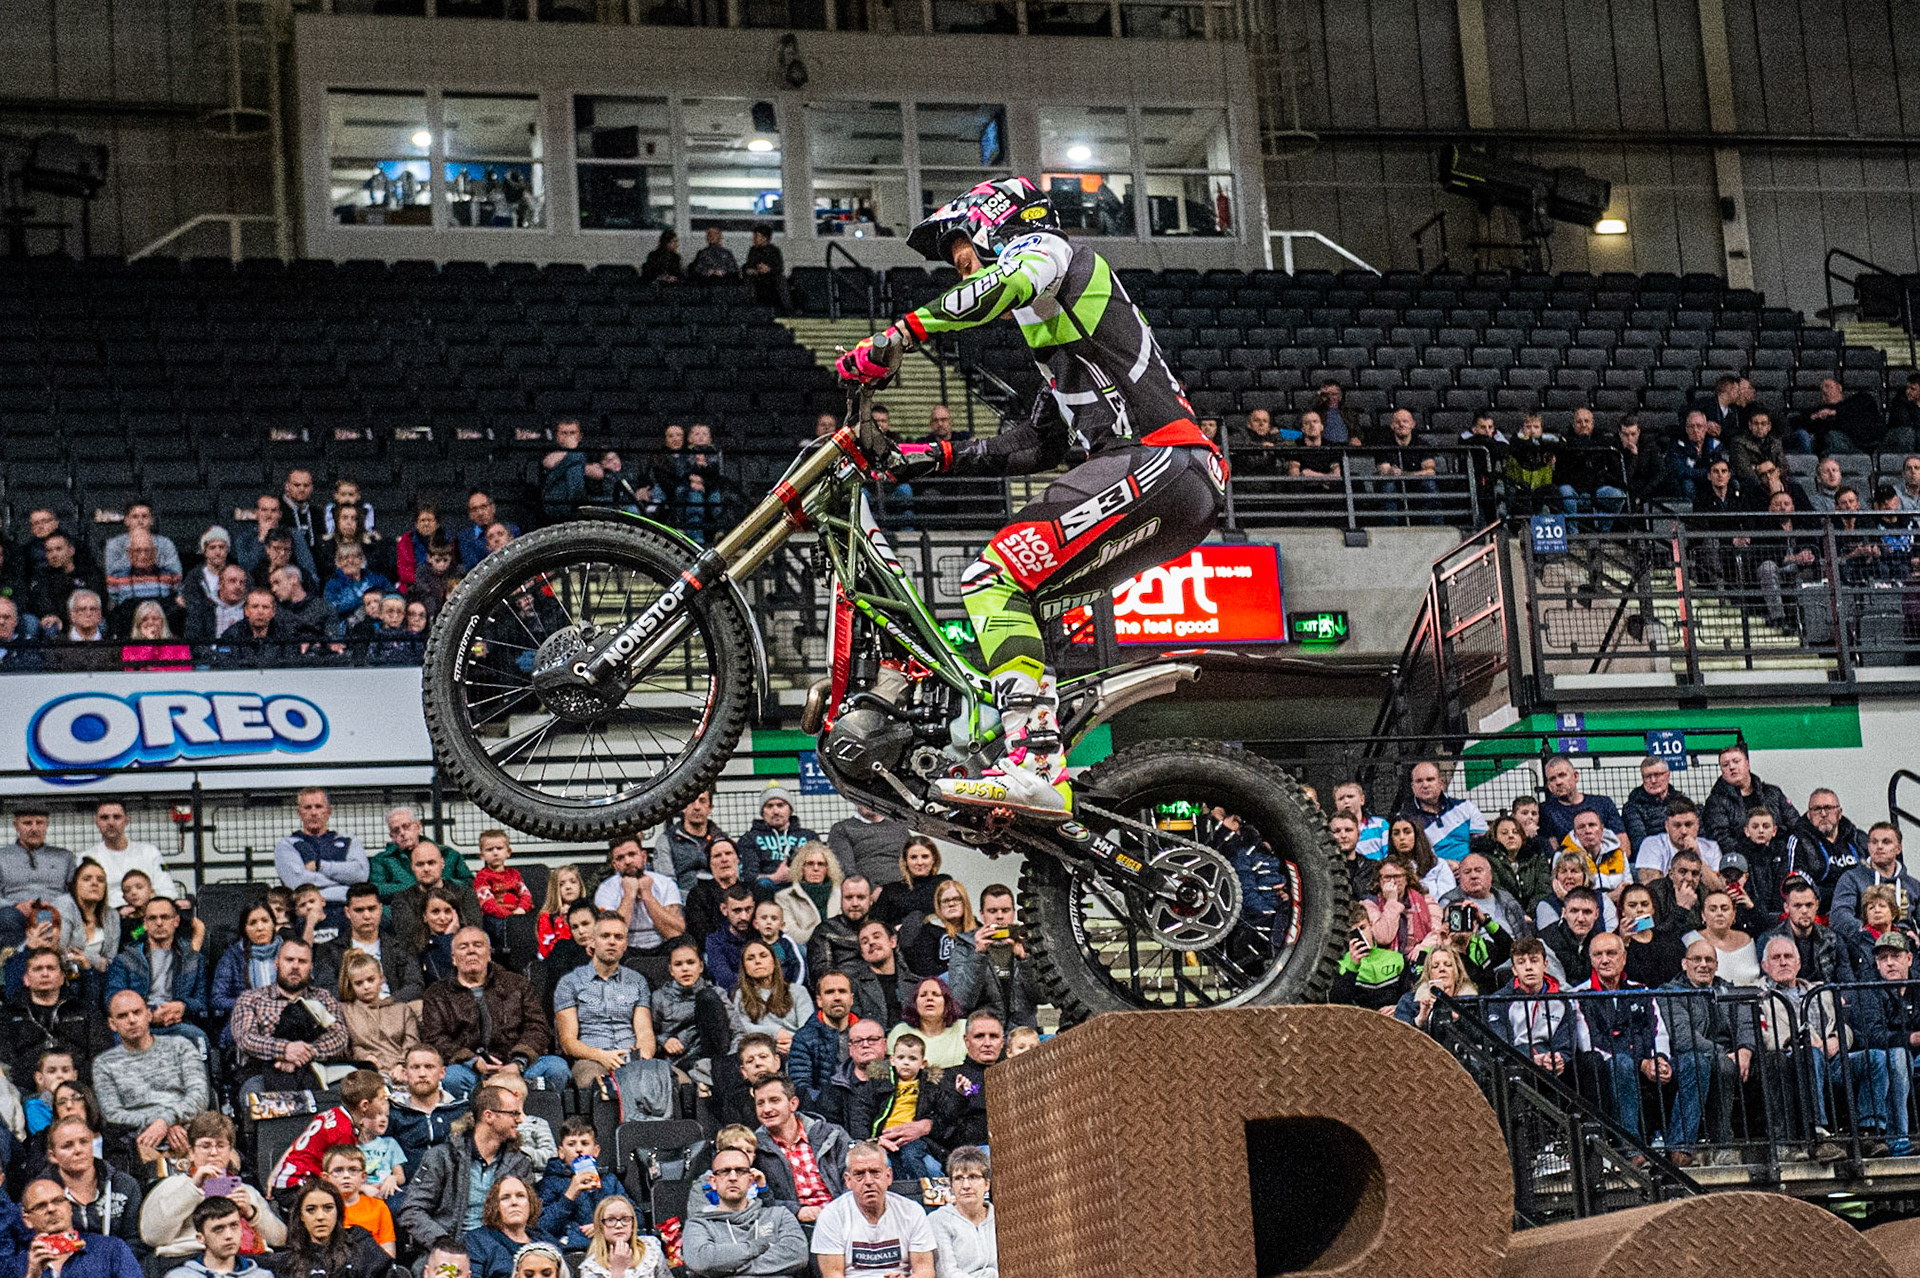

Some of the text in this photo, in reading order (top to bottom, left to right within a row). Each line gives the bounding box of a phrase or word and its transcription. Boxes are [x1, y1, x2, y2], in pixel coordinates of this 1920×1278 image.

[980, 190, 1007, 213] NON
[988, 199, 1012, 221] STOP
[1535, 525, 1564, 539] 210
[1003, 533, 1043, 573] STOP
[1019, 526, 1059, 569] NON
[602, 581, 686, 668] NONSTOP
[1143, 618, 1172, 635] feel
[1174, 618, 1220, 637] good!
[1295, 619, 1319, 632] EXIT
[29, 691, 328, 774] OREO
[1652, 740, 1683, 755] 110
[953, 780, 1007, 801] BUSTO
[1092, 836, 1114, 856] HH
[855, 1250, 899, 1262] ORIGINALS
